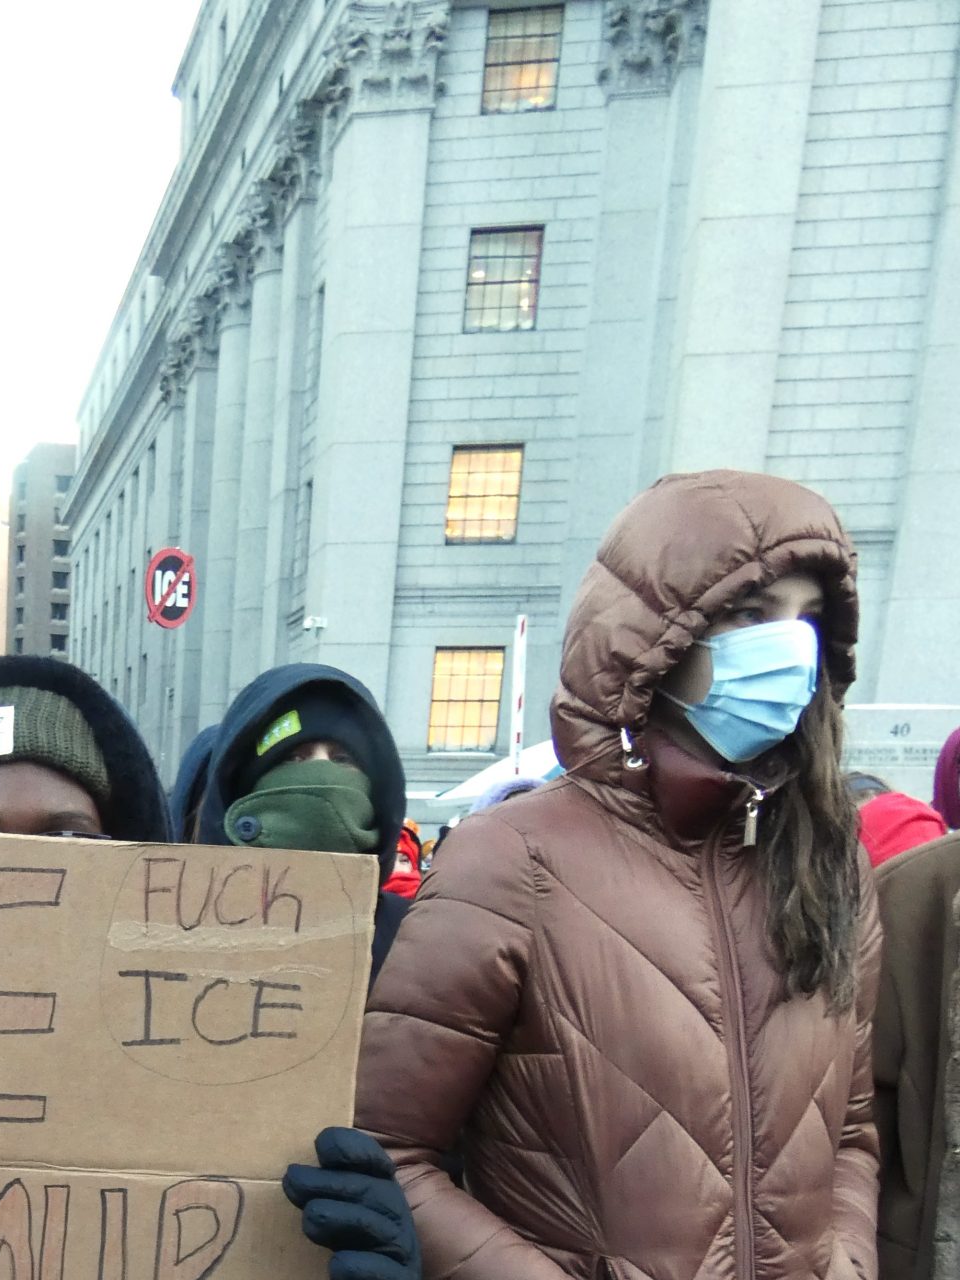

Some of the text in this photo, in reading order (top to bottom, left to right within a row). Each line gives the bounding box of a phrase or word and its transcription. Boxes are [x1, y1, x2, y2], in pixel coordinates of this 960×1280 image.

[154, 570, 190, 608] ICE
[889, 722, 911, 737] 40
[119, 970, 302, 1047] ICE
